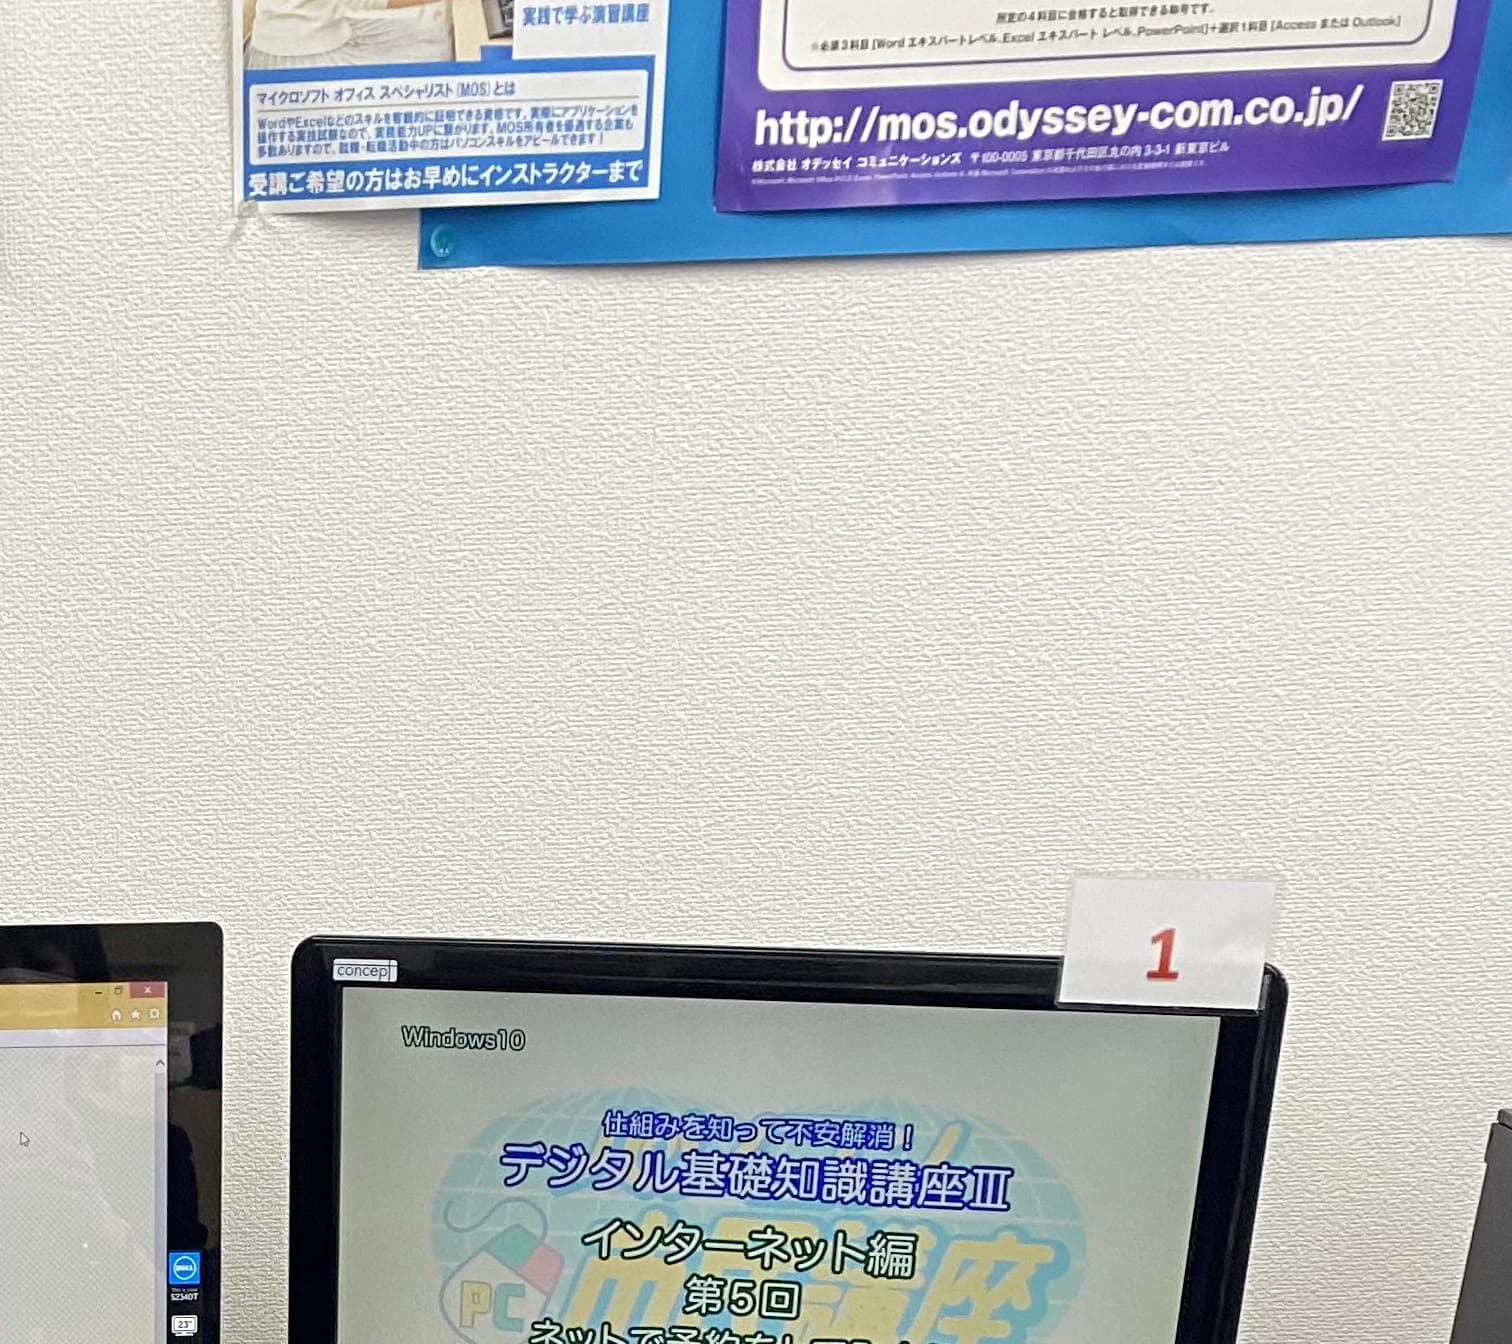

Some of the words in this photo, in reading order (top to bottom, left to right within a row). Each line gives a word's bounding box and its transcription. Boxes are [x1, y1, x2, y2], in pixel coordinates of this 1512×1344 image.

[256, 90, 329, 106] マイクロソフト
[335, 87, 376, 101] オフィス
[381, 83, 453, 99] スペシャリスト
[755, 84, 1364, 148] http://mos.odyssey-com.co.jp/
[249, 159, 644, 196] 受講ご希望の方はお早めにインストラクターまで
[1146, 928, 1179, 980] 1
[401, 1025, 526, 1052] Windows10
[602, 1108, 917, 1152] 仕組みを知って不安解消！
[581, 1217, 919, 1280] インターネット編
[683, 1274, 803, 1321] 第5回
